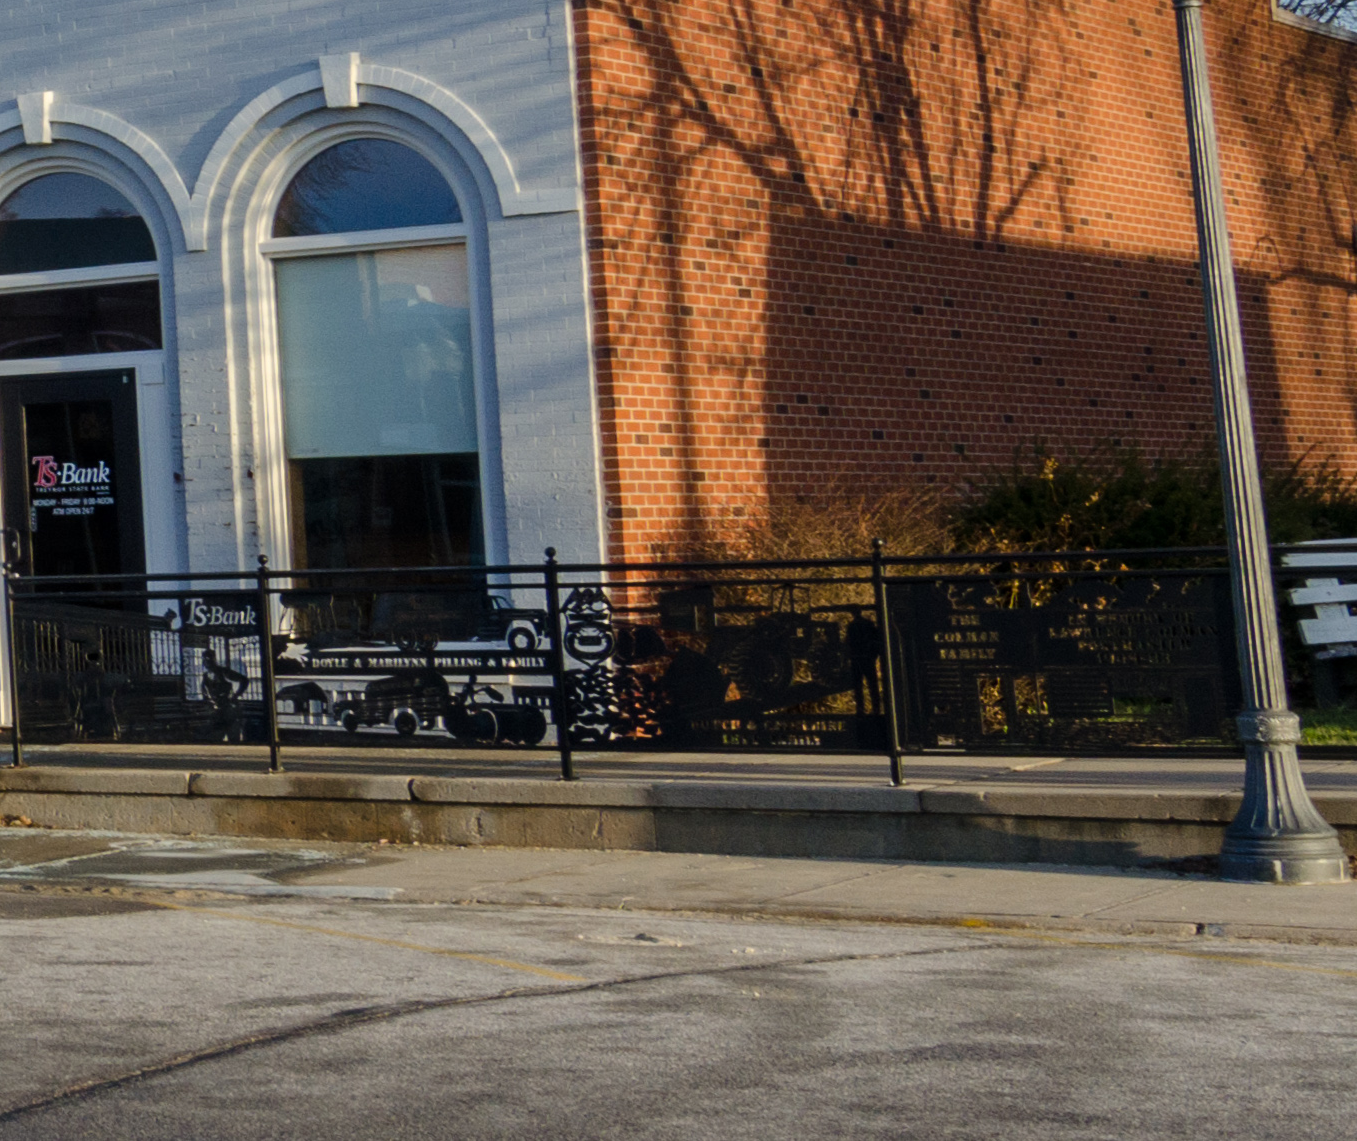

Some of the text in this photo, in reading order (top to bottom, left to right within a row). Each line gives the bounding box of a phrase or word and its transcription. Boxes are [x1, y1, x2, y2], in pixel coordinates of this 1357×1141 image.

[61, 498, 81, 506] FRIDAY
[65, 507, 81, 515] OPEN
[939, 648, 996, 659] FAMILY
[311, 656, 546, 668] DOYLE & MARILYNN PILLING & FAMILY
